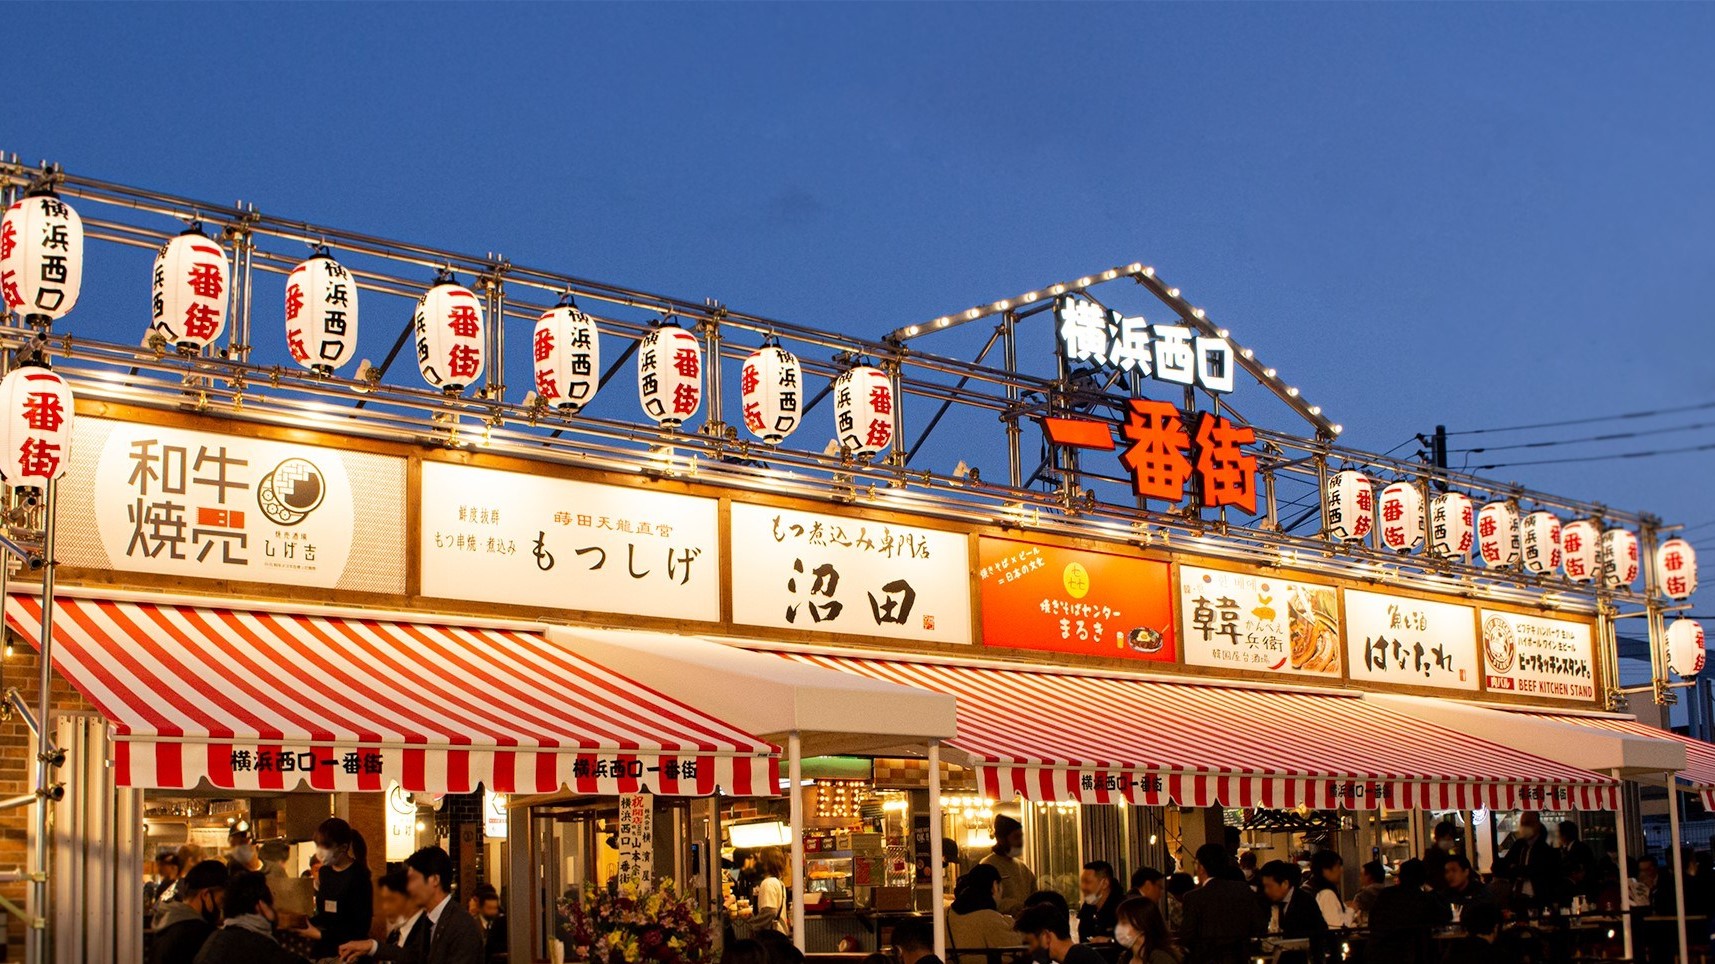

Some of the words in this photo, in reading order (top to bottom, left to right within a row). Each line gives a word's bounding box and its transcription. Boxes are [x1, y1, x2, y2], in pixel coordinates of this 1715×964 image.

[35, 199, 69, 311] 横浜西口
[184, 245, 223, 341] 一番街
[285, 266, 310, 362] 一番街
[320, 260, 348, 360] 横浜西口
[448, 290, 480, 378] 一番街
[533, 313, 561, 400] 一番街
[568, 309, 591, 399] 横浜西口
[1060, 297, 1235, 393] 横浜西口
[641, 331, 665, 417] 横浜西口
[673, 333, 700, 416] 一番街
[741, 352, 767, 433] 一番街
[774, 350, 797, 432] 横浜西口
[19, 374, 64, 479] 一番街
[837, 370, 863, 451] 横浜西口
[865, 372, 892, 448] 一番街
[128, 439, 249, 504] 和牛
[1040, 398, 1259, 516] 一番街
[126, 497, 248, 566] 焼売
[459, 505, 499, 525] 鮮度抜群
[554, 511, 673, 537] 蒔田天龍直営
[772, 514, 931, 559] もつ煮込み専門店
[1328, 475, 1348, 538] 横浜西口
[1353, 478, 1372, 536] 一番街
[1383, 488, 1405, 547] 一番街
[1457, 496, 1474, 551] 一番街
[1479, 506, 1501, 563] 一番街
[265, 540, 316, 561] しげ吉
[532, 530, 701, 585] もつしげ
[1524, 515, 1544, 571] 横浜西口
[1564, 523, 1586, 577] 一番街
[1664, 542, 1686, 595] 一番街
[786, 558, 916, 626] 沼田
[1039, 598, 1121, 620] 焼きそばセンター
[1059, 617, 1104, 643] まるき
[1212, 649, 1271, 664] 韓国屋台酒場
[1365, 635, 1455, 677] はなたれ
[1519, 652, 1591, 679] ビーフキッチンスタンド。
[1519, 679, 1537, 691] BEEF
[1539, 681, 1568, 695] KITCHEN
[1571, 684, 1593, 698] STAND
[230, 750, 384, 774] 横浜西口一番街
[573, 758, 697, 780] 横浜西口一番街
[1081, 775, 1162, 792] 横浜西口一番街
[620, 798, 631, 884] 横浜西口一番街
